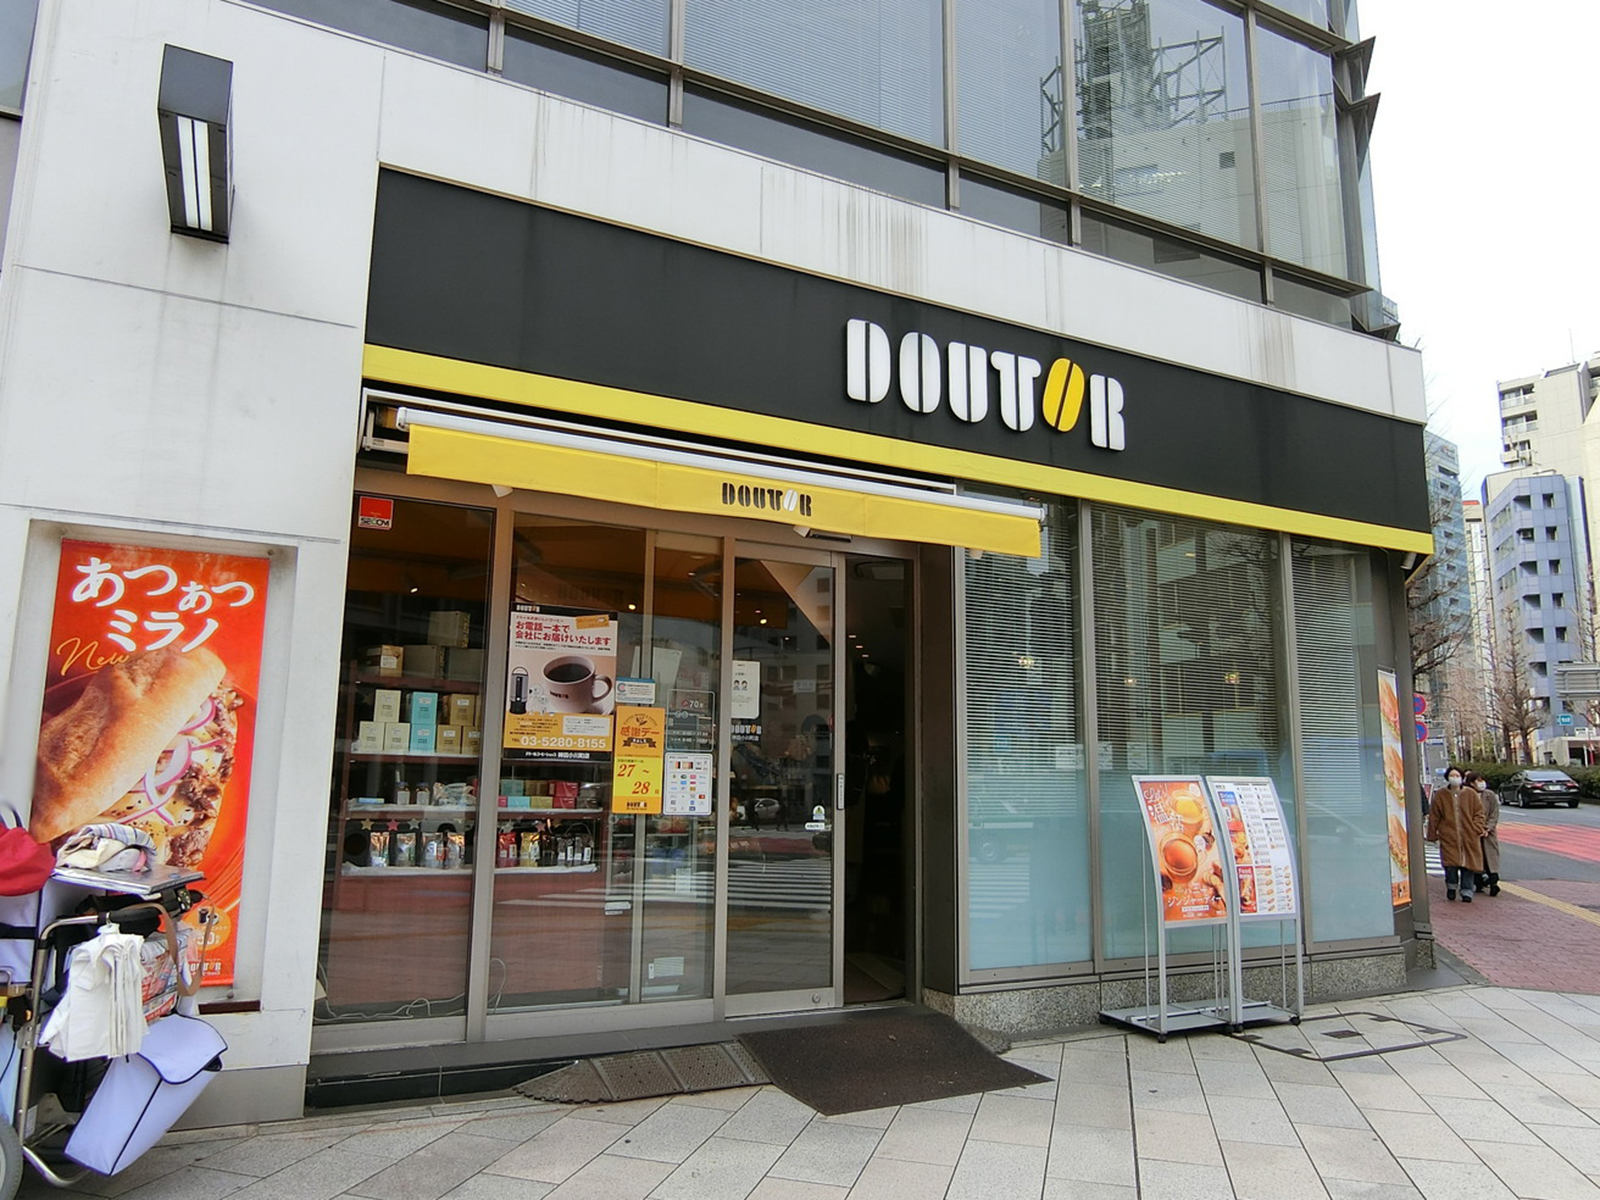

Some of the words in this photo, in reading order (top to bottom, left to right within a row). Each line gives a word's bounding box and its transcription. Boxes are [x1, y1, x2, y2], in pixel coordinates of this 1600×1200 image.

[847, 318, 1126, 451] DOUTOR
[722, 482, 812, 517] DOUTOR
[360, 517, 390, 527] SECOM
[107, 609, 219, 653] ミラノ
[516, 621, 570, 633] お電話一本で
[515, 630, 611, 646] 会社にお届けいたします
[56, 637, 130, 676] New
[620, 726, 660, 737] 感謝デー
[521, 736, 606, 748] 03-5280-8155
[617, 763, 636, 777] 27
[632, 781, 651, 795] 28
